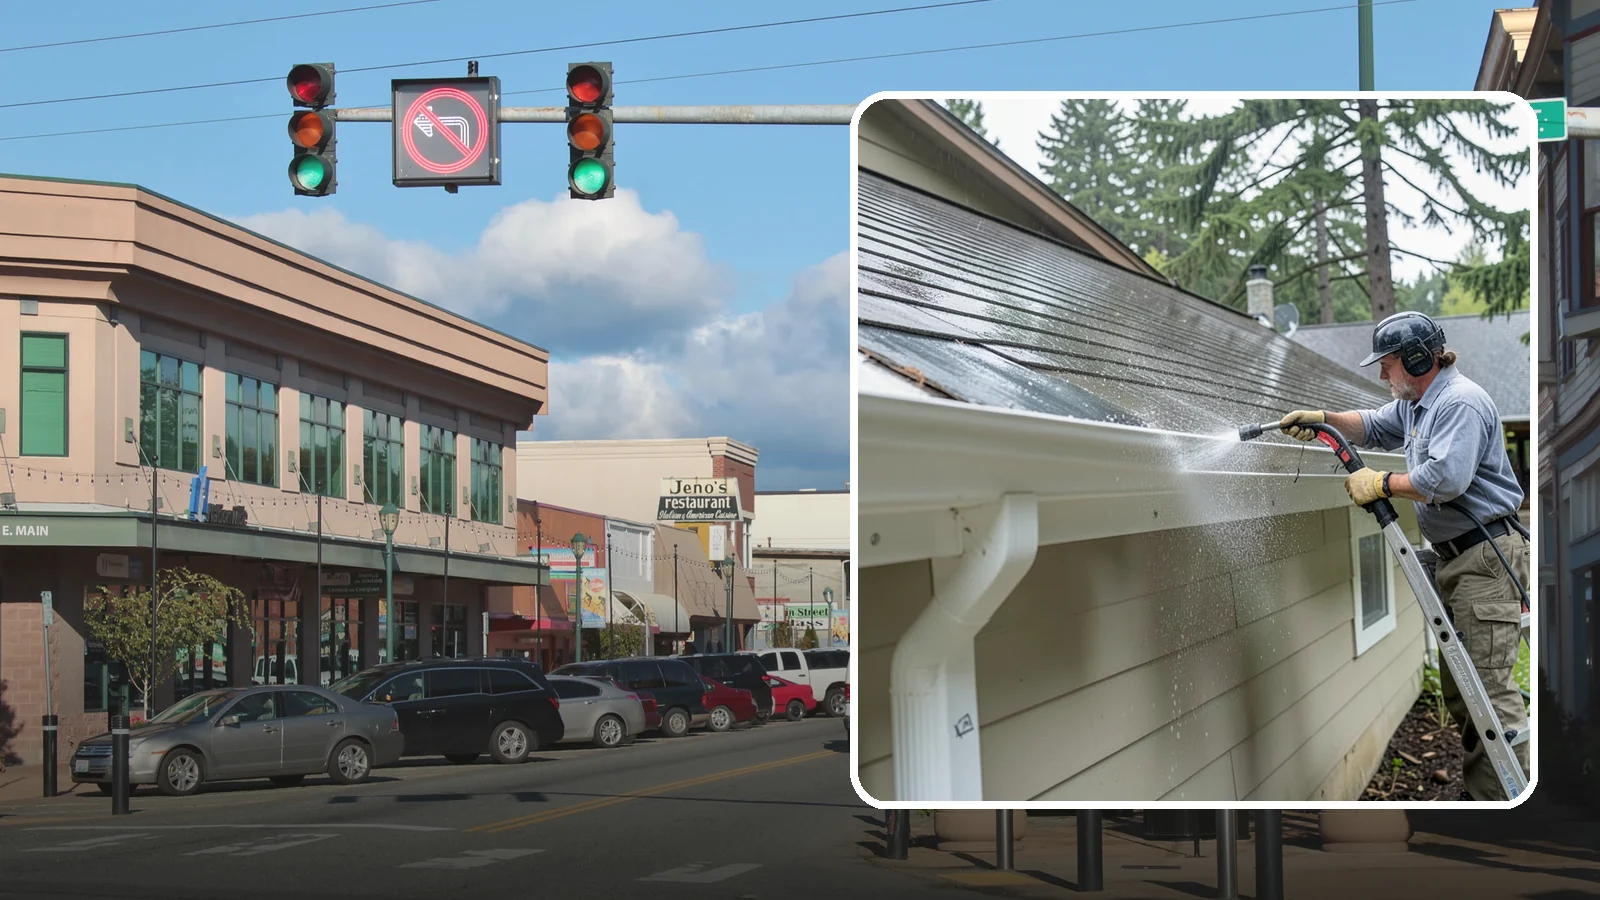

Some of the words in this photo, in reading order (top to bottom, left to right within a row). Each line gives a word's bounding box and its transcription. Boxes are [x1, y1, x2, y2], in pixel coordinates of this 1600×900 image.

[670, 480, 727, 494] Jeno's
[665, 497, 731, 508] restaurant
[686, 509, 715, 519] American
[715, 509, 738, 519] Cuisine
[2, 525, 13, 536] E.
[15, 525, 49, 536] MAIN
[796, 607, 828, 616] Street
